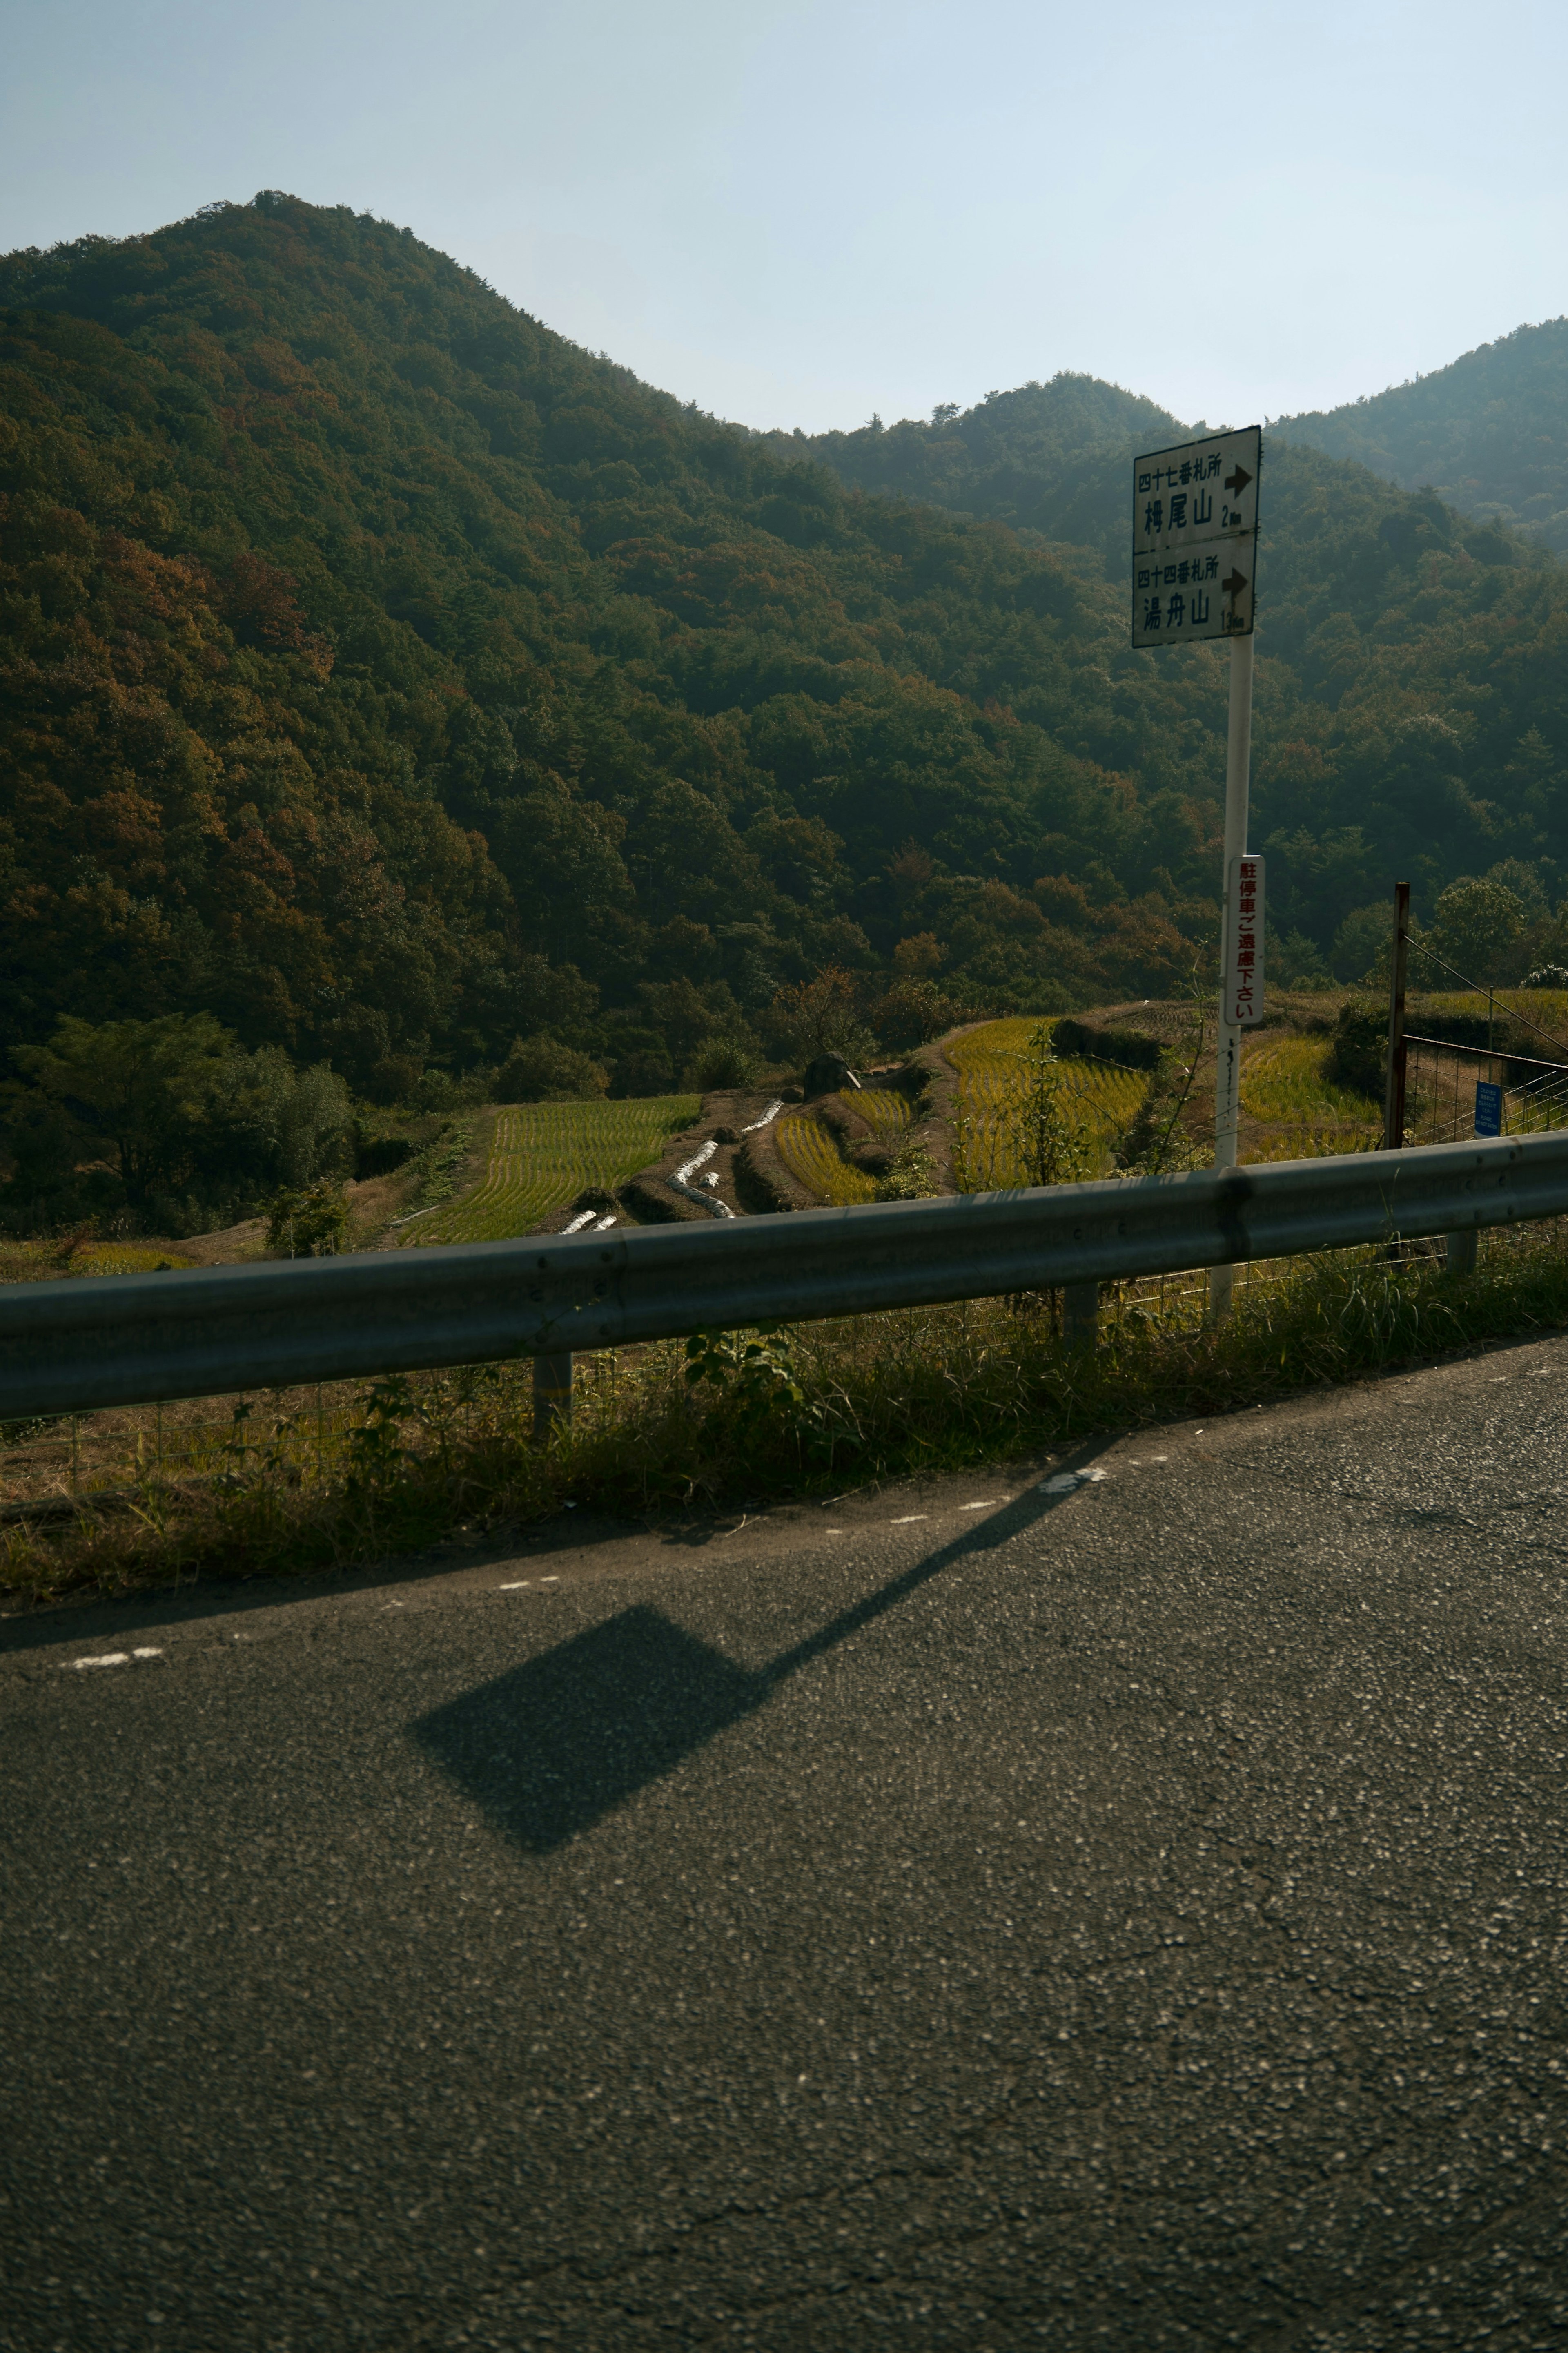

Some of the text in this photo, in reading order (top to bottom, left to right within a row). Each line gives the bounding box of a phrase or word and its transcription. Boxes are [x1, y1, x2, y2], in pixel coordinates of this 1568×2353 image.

[1139, 452, 1222, 493] 四十七番札所
[1145, 488, 1212, 535] 栂尾山
[1138, 555, 1219, 588] 四十四番札所
[1144, 589, 1209, 631] 湯舟山
[1236, 863, 1257, 1018] 駐停車ご遠慮下さい
